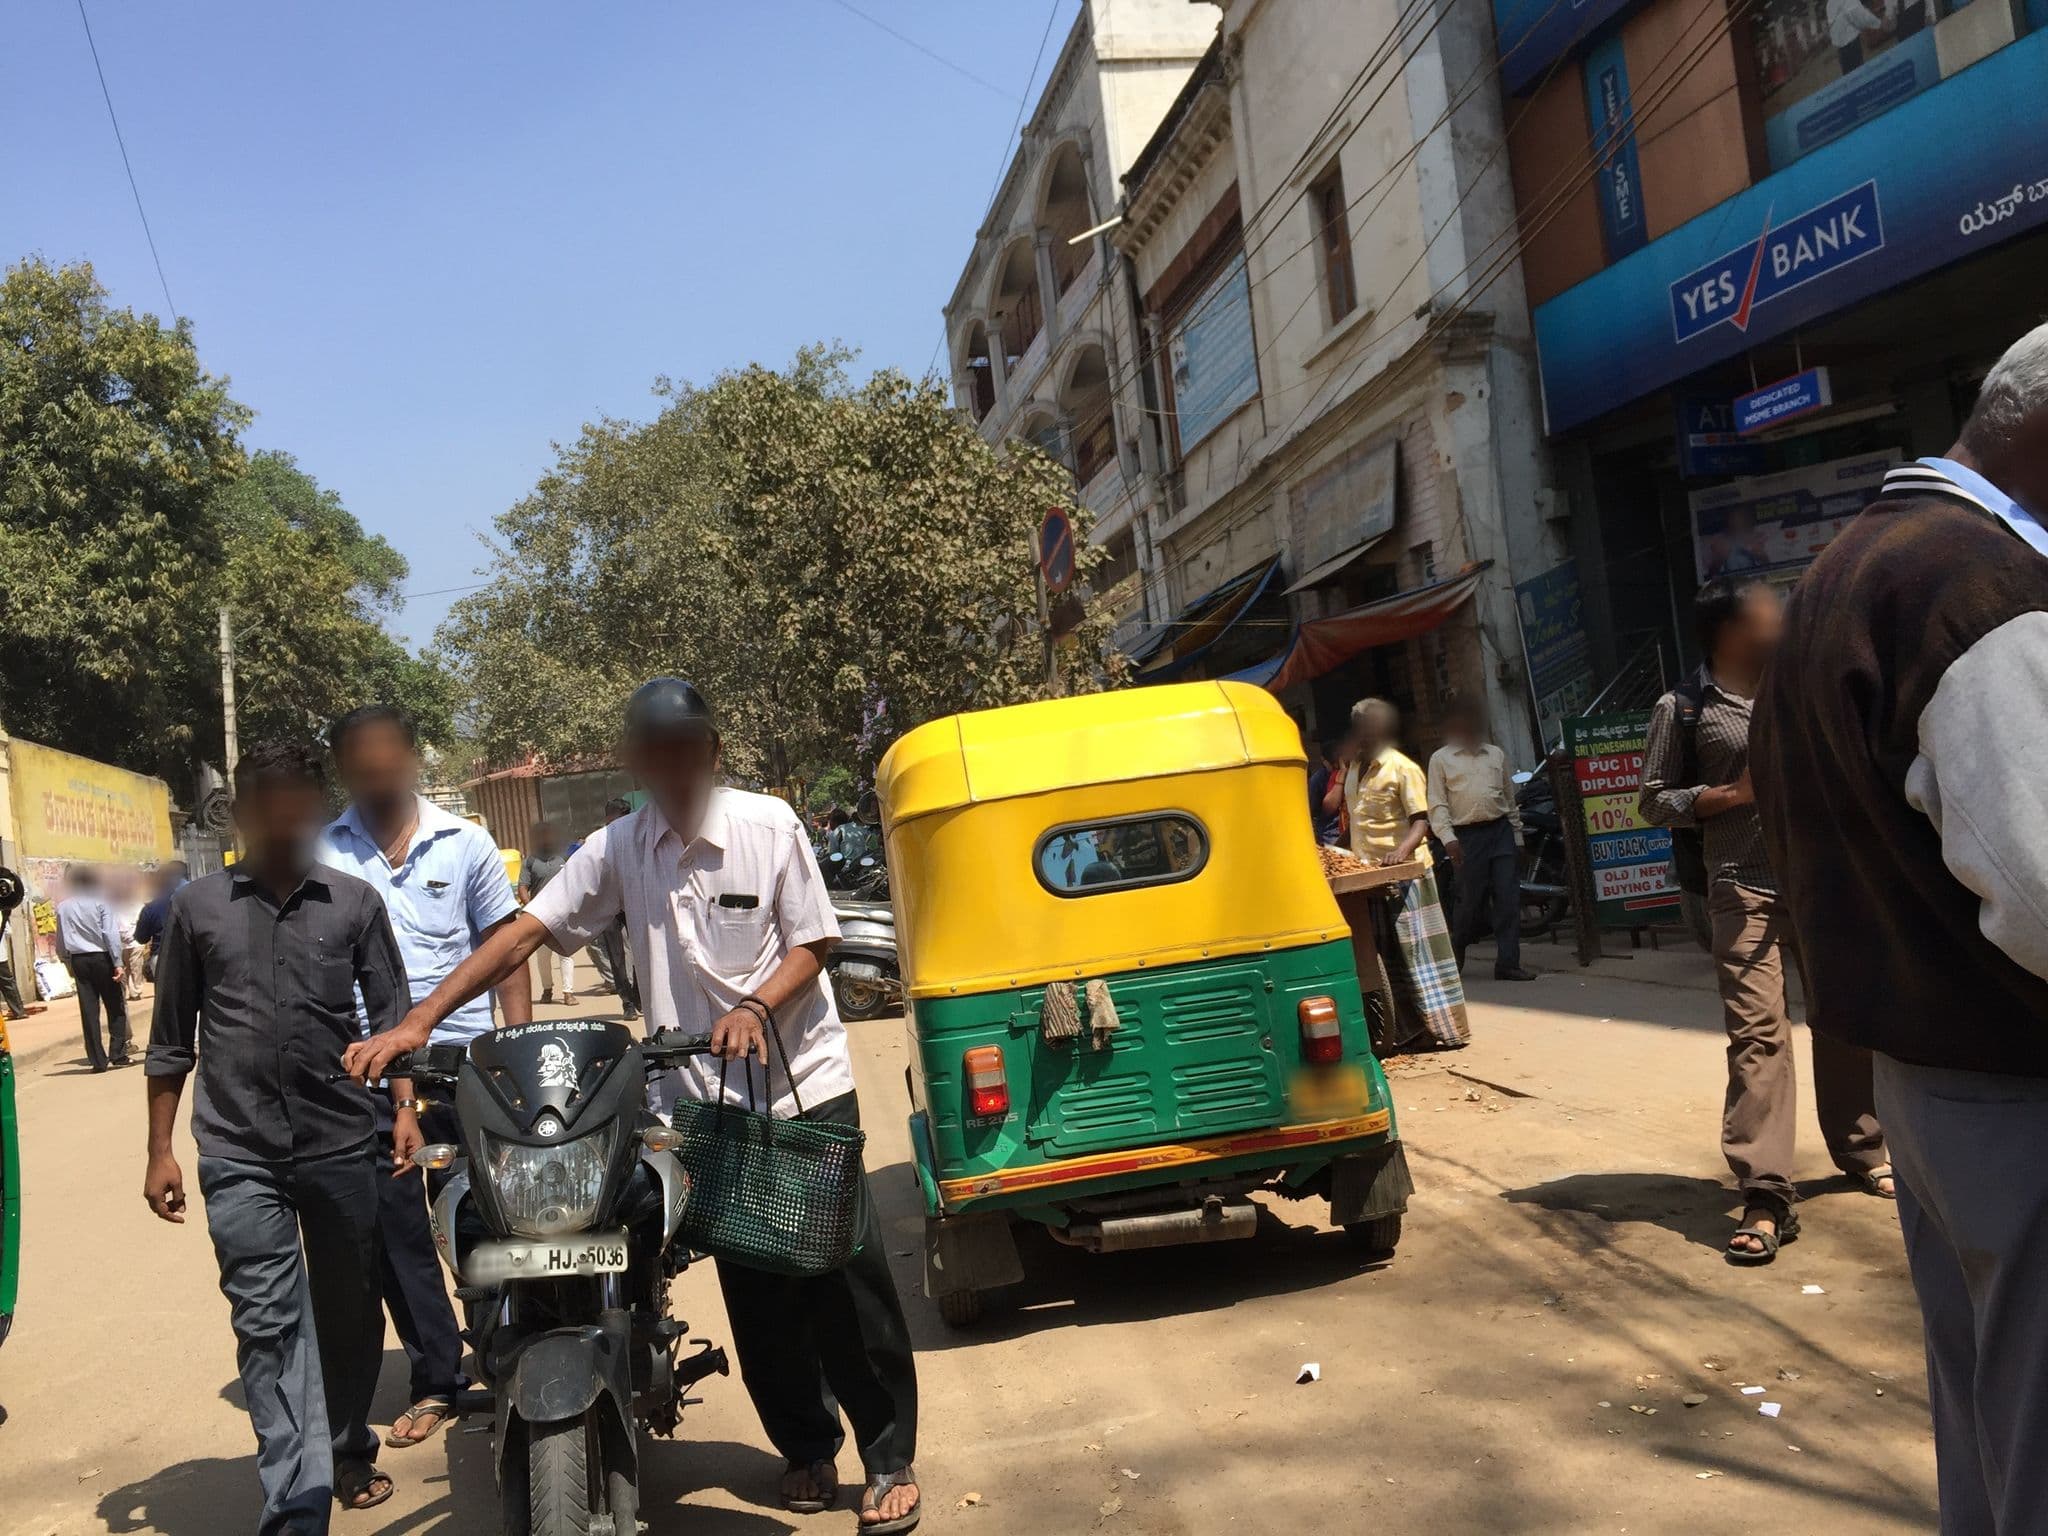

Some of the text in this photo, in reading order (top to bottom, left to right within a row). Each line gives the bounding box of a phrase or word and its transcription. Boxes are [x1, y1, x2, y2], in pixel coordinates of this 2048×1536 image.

[1615, 163, 1631, 220] SME
[1681, 204, 1867, 321] YES BANK
[1750, 382, 1801, 410] DEDICATED
[1772, 393, 1812, 415] BRANCH
[1699, 404, 1729, 431] AT
[1575, 744, 1588, 757] SRI
[1589, 759, 1620, 773] PUC
[1632, 756, 1643, 769] D
[1581, 774, 1639, 792] DIPLOM
[1604, 796, 1633, 806] VTU
[1590, 808, 1633, 831] 10%
[1592, 840, 1615, 862] BUY
[1616, 836, 1648, 859] BACK
[1604, 870, 1629, 882] OLD
[1639, 864, 1668, 878] NEW
[1603, 879, 1665, 897] BUYING &
[965, 1117, 987, 1129] RE
[585, 1246, 624, 1267] 5036
